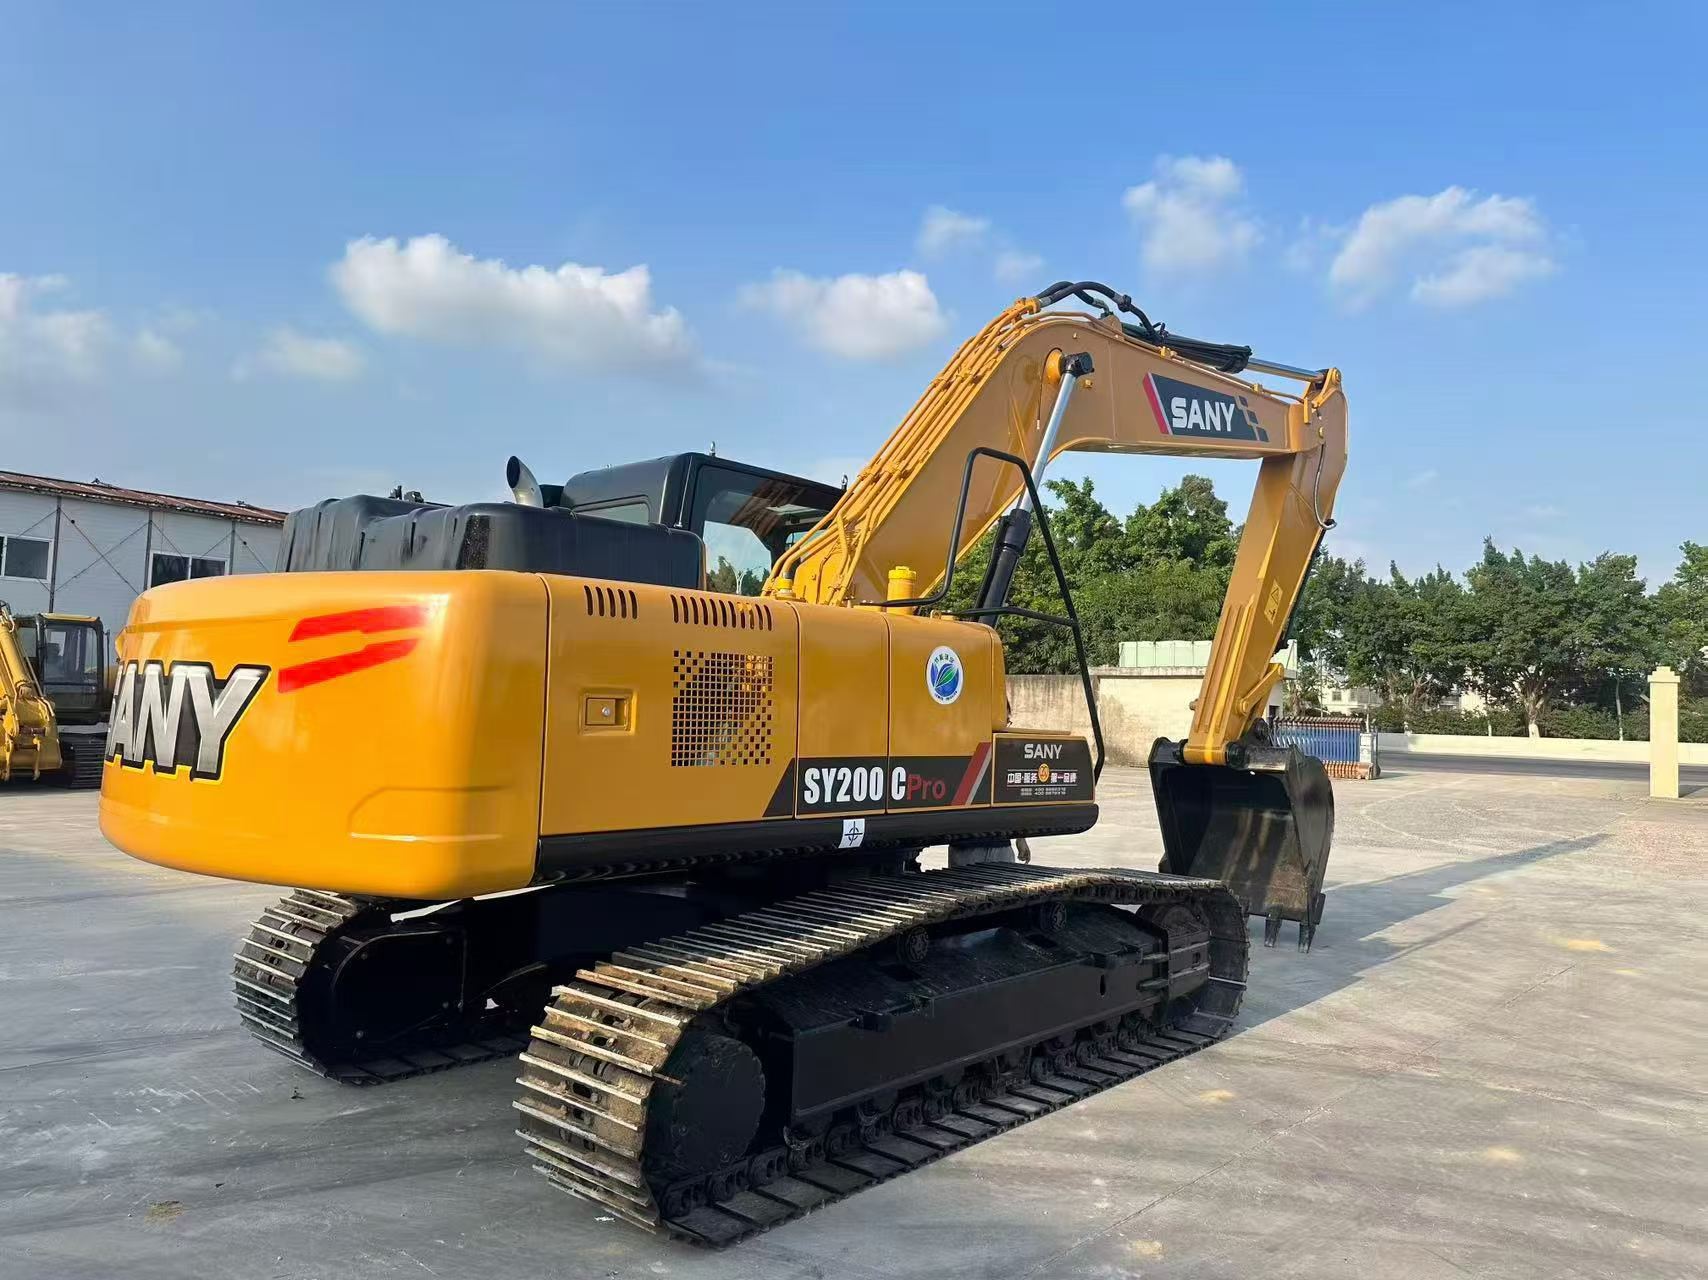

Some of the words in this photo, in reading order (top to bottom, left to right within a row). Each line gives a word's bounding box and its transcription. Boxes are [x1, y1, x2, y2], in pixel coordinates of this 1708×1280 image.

[1171, 396, 1235, 432] SANY
[1024, 743, 1062, 760] SANY
[804, 766, 883, 804] SY200
